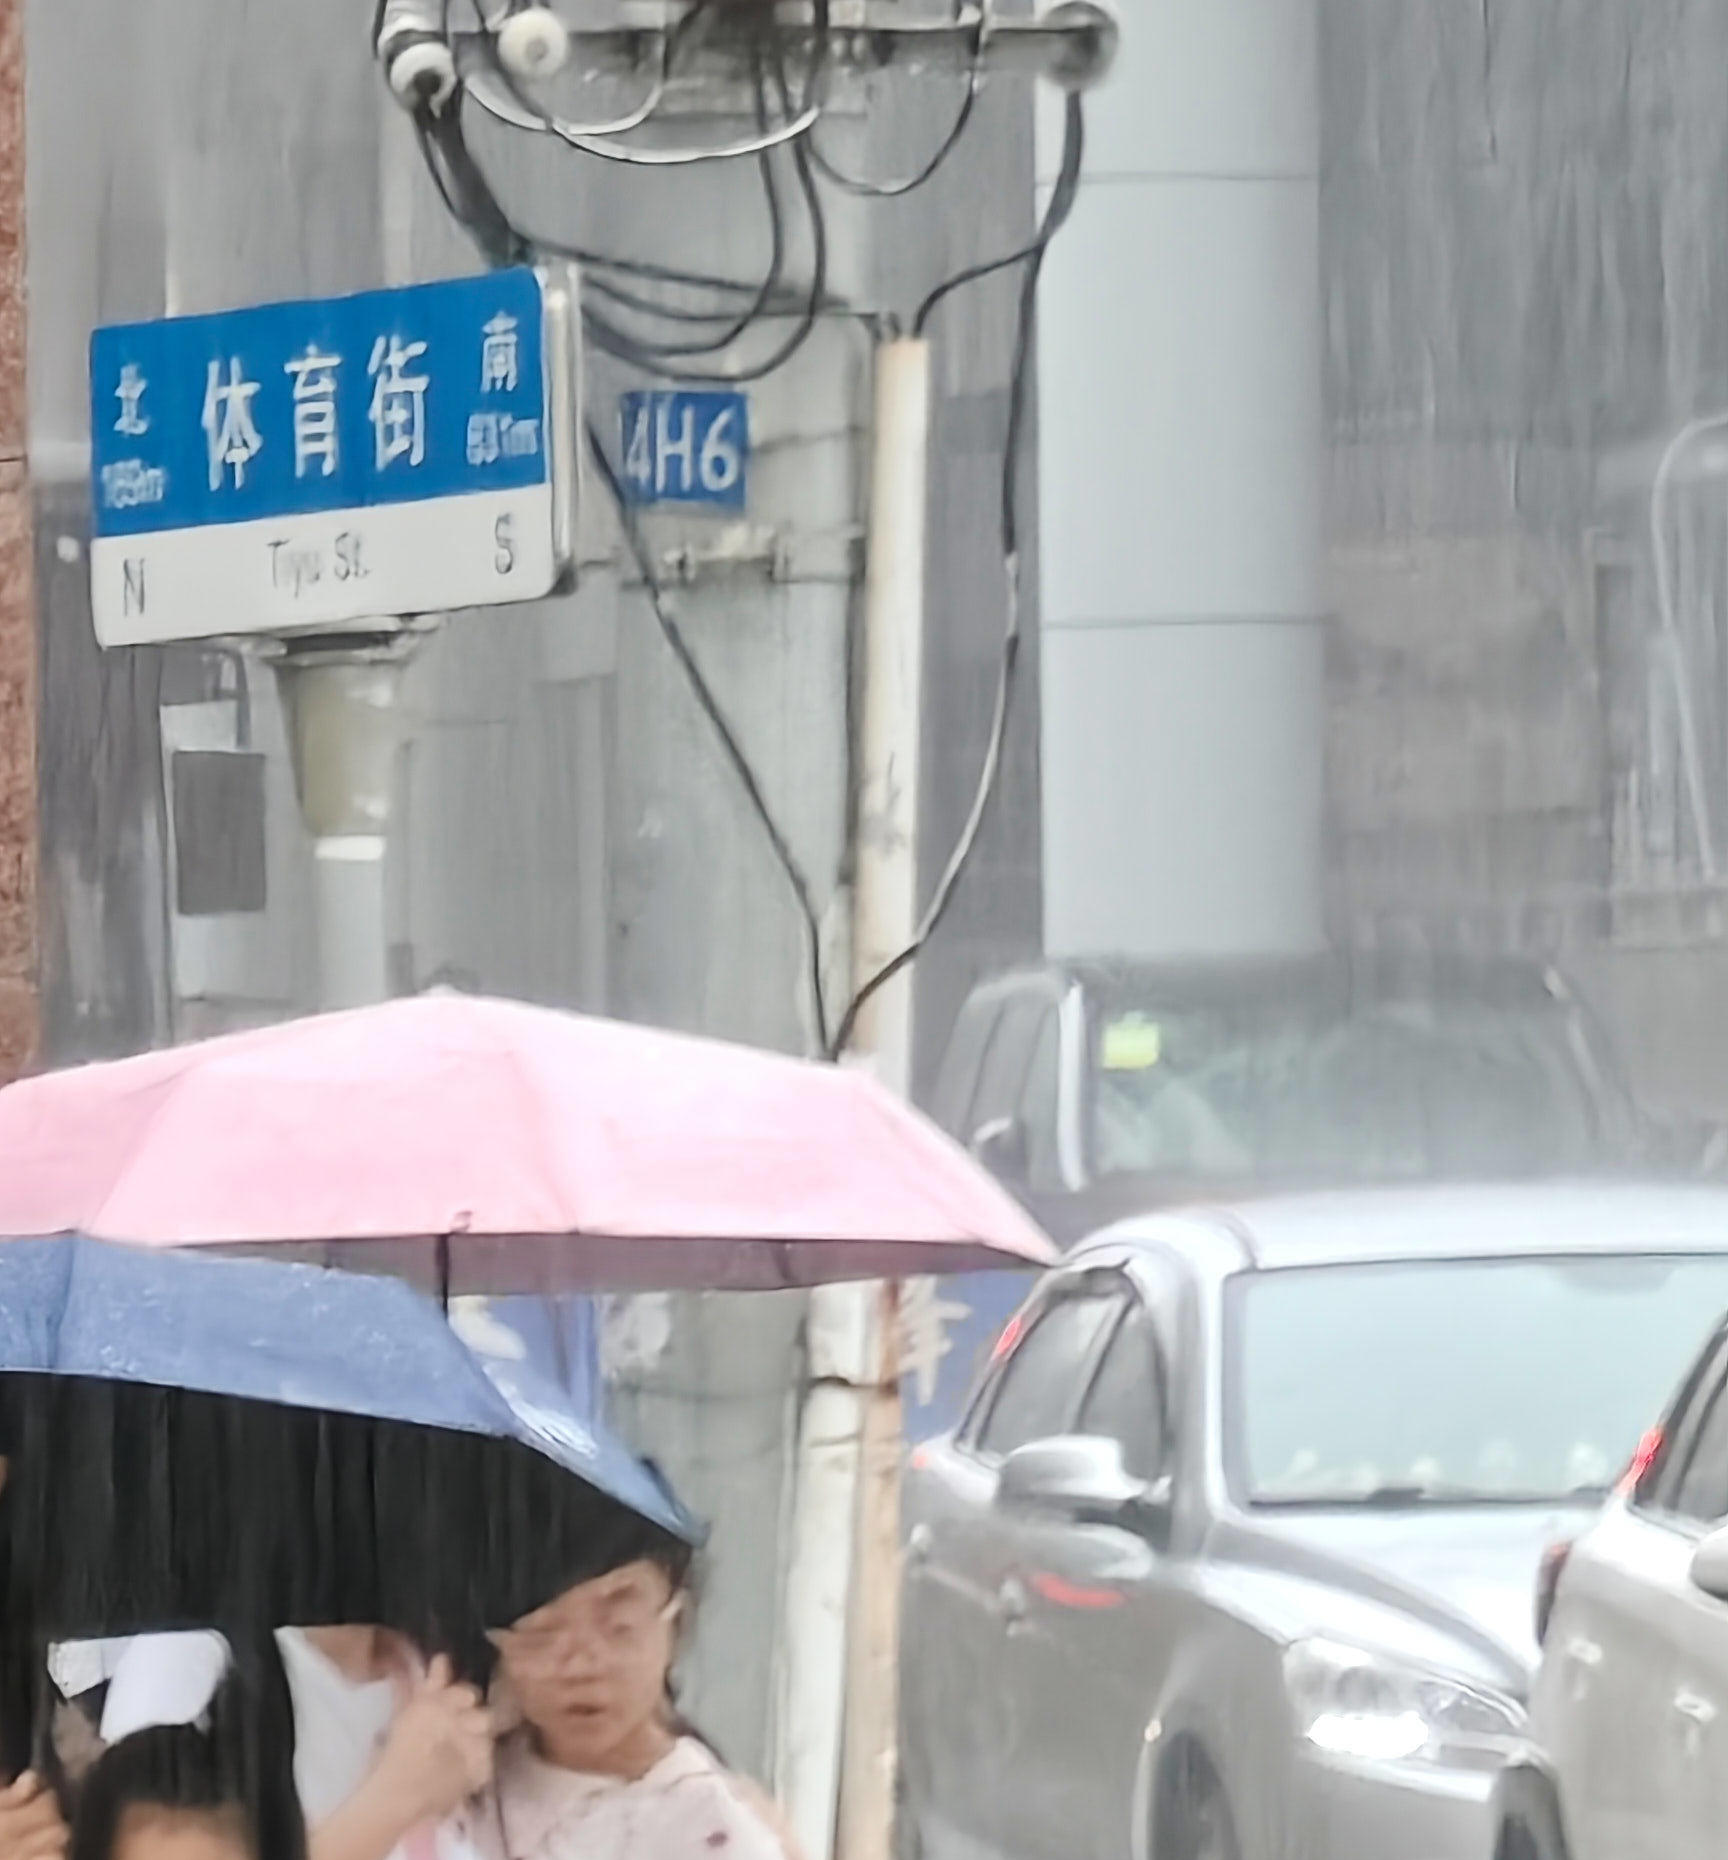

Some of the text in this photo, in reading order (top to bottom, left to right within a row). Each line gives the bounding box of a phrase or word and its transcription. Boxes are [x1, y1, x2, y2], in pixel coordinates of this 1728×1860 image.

[113, 309, 519, 492] 北 体育街 南
[122, 557, 146, 617] N
[493, 514, 516, 576] S
